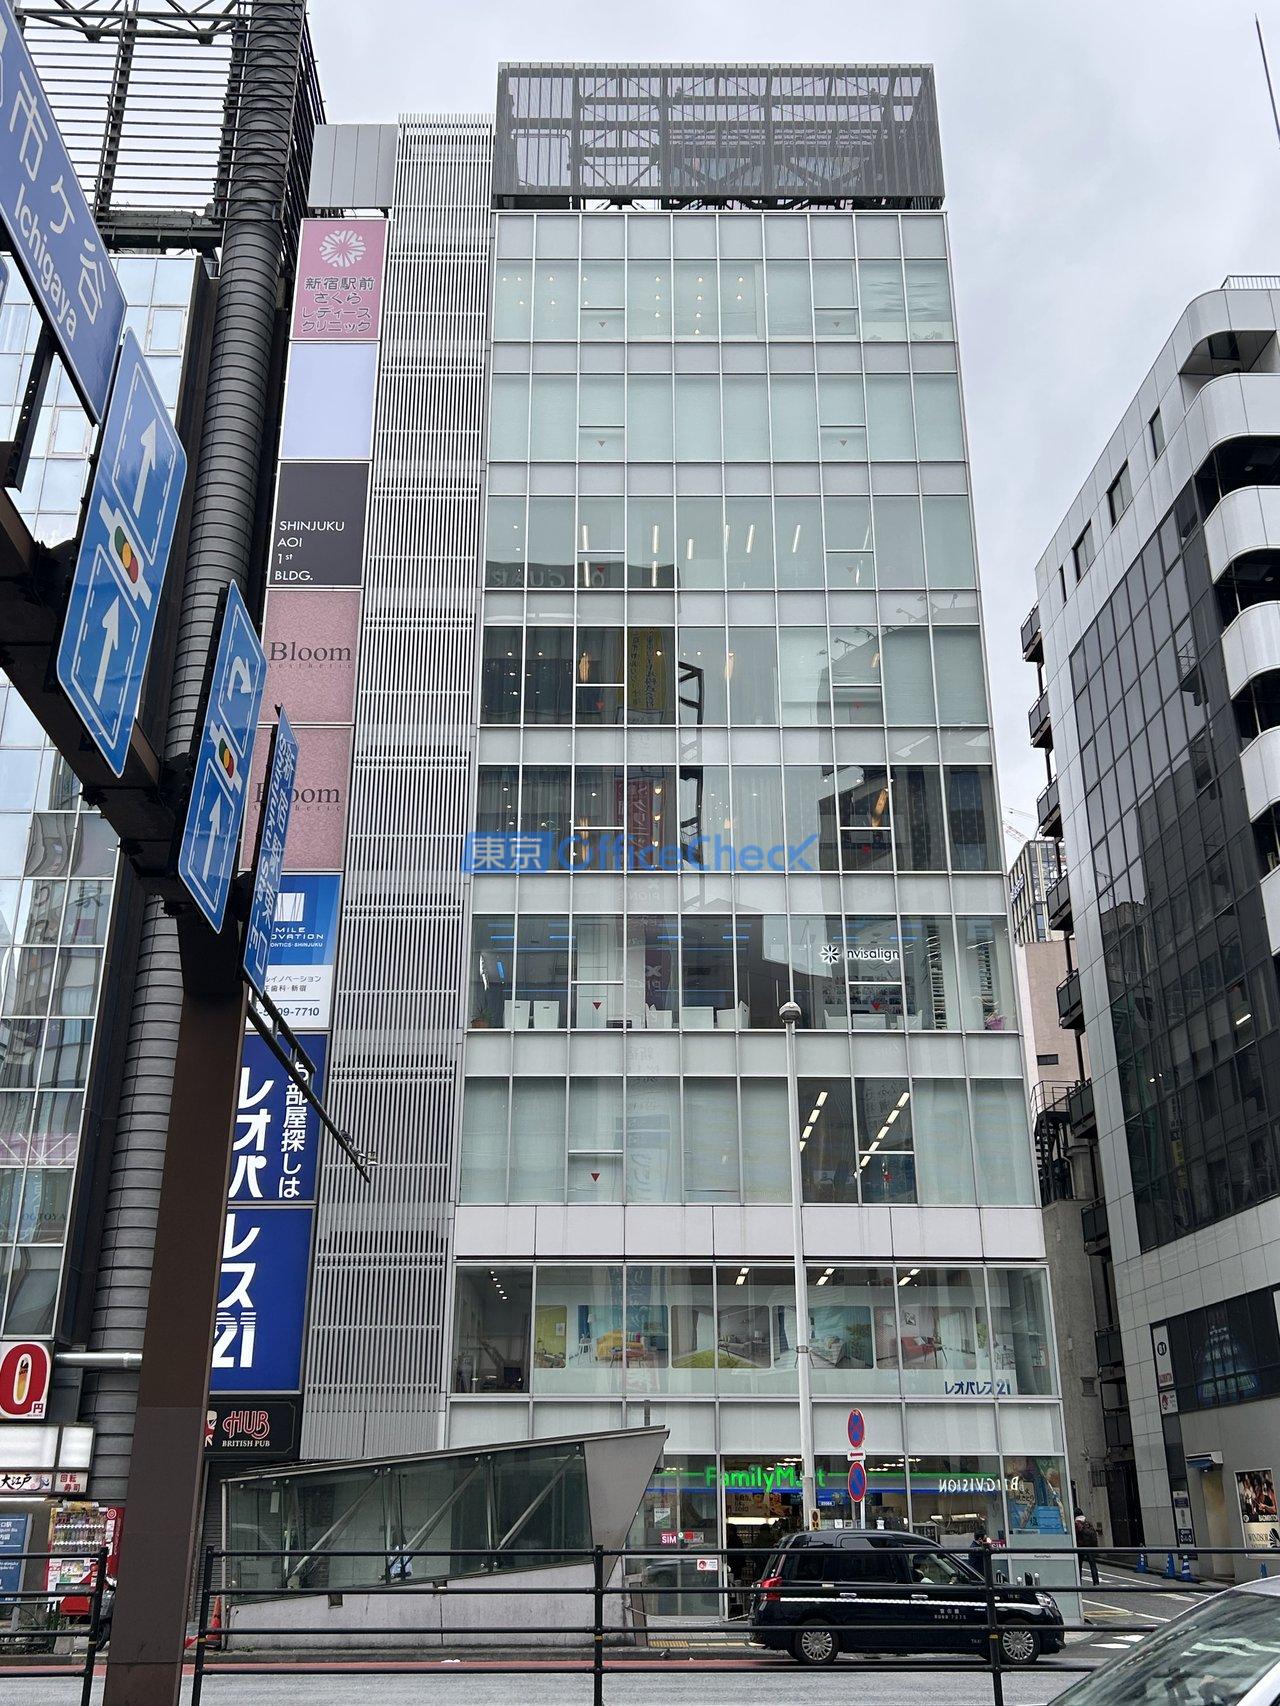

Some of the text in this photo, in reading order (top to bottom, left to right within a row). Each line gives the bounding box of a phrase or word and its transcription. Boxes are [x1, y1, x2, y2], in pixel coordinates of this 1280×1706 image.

[14, 183, 77, 342] Ichigaya
[305, 277, 375, 290] 新宿駅前
[314, 292, 362, 304] さくら
[302, 307, 371, 318] レディース
[302, 321, 371, 332] クリニック
[279, 520, 345, 531] SHINJUKU
[277, 537, 302, 548] AOI
[277, 554, 293, 564] 1st
[275, 571, 314, 581] BLDG.
[269, 641, 352, 661] Bloom
[265, 732, 287, 848] Shinjuku
[278, 1062, 310, 1198] お部屋探しは
[222, 1410, 270, 1440] HUB
[1, 1474, 32, 1491] 大江戸
[60, 1474, 77, 1483] 回転
[64, 1483, 81, 1492] 寿司
[661, 1535, 677, 1544] SIM
